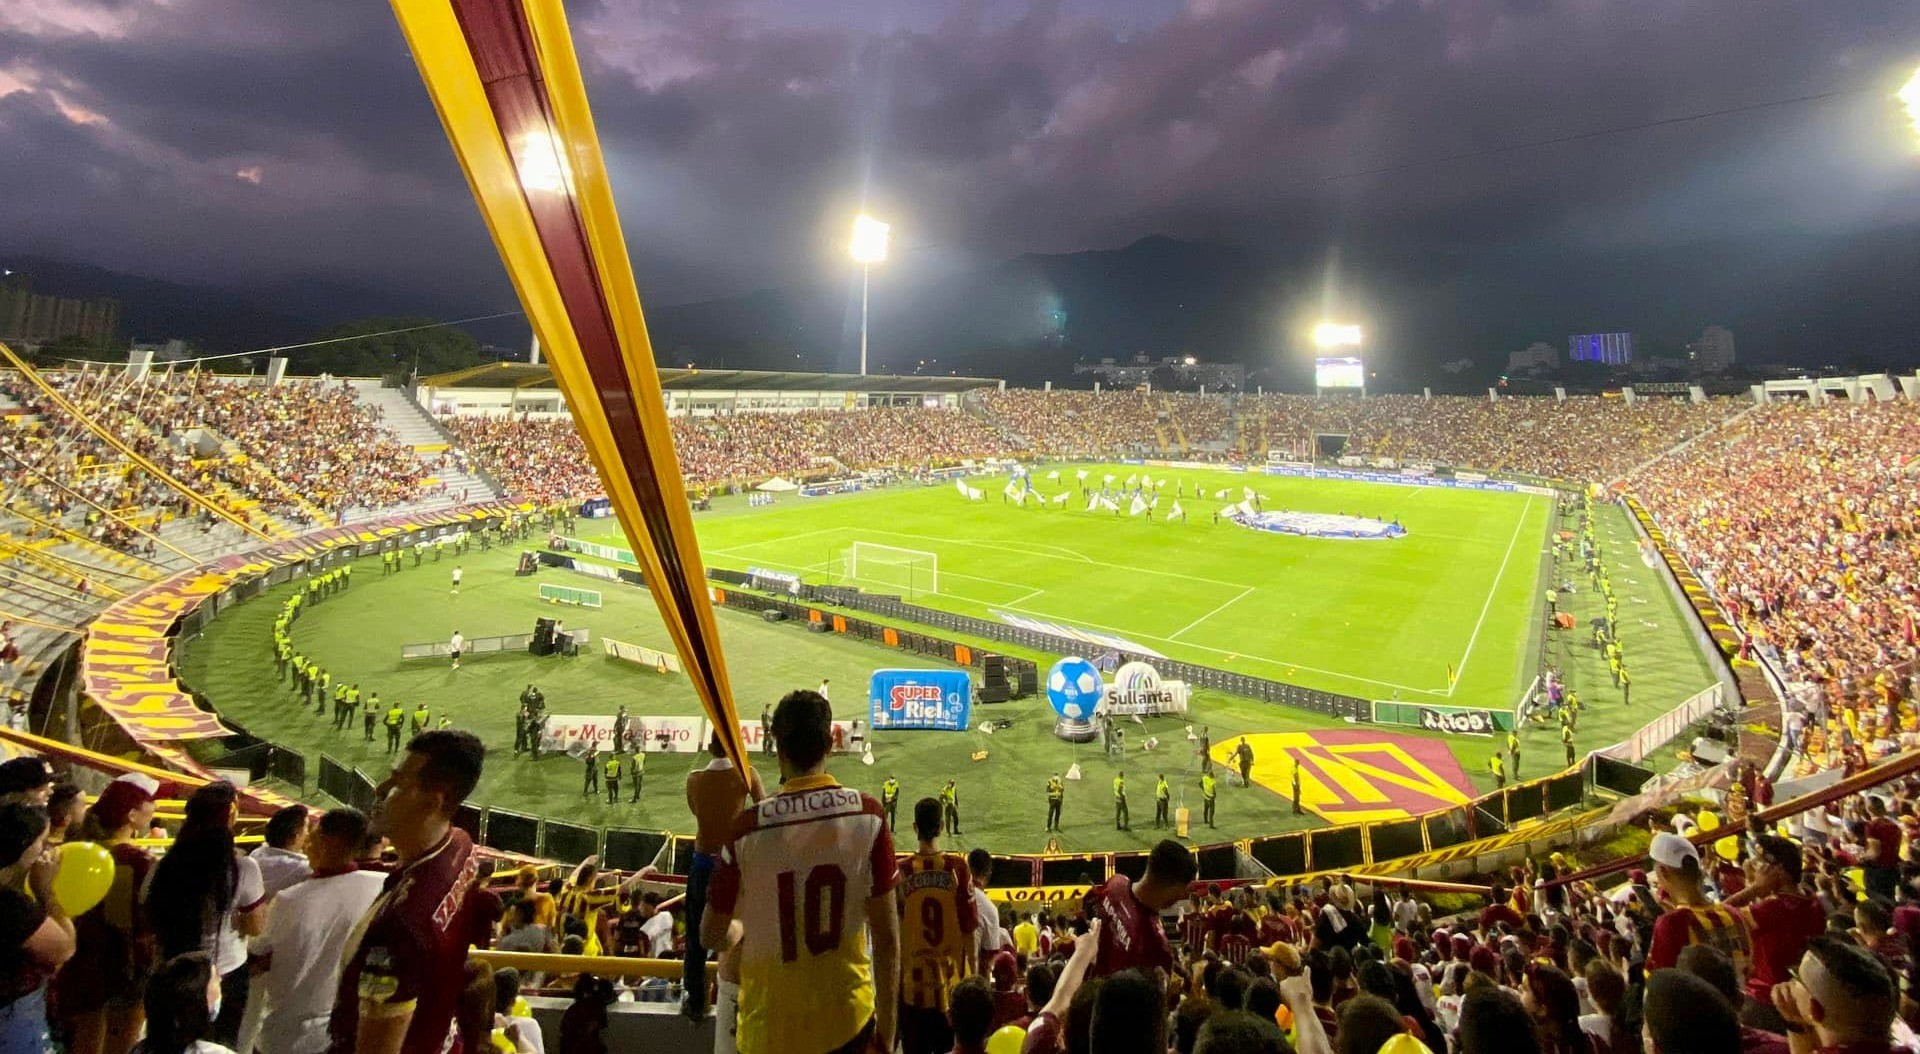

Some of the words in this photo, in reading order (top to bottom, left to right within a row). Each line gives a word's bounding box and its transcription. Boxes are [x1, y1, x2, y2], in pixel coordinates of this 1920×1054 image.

[890, 686, 941, 711] SUPER
[905, 701, 942, 719] Riel
[1108, 690, 1172, 705] Sullanta
[762, 788, 860, 818] concasa
[776, 864, 847, 963] 10
[921, 896, 944, 947] 9
